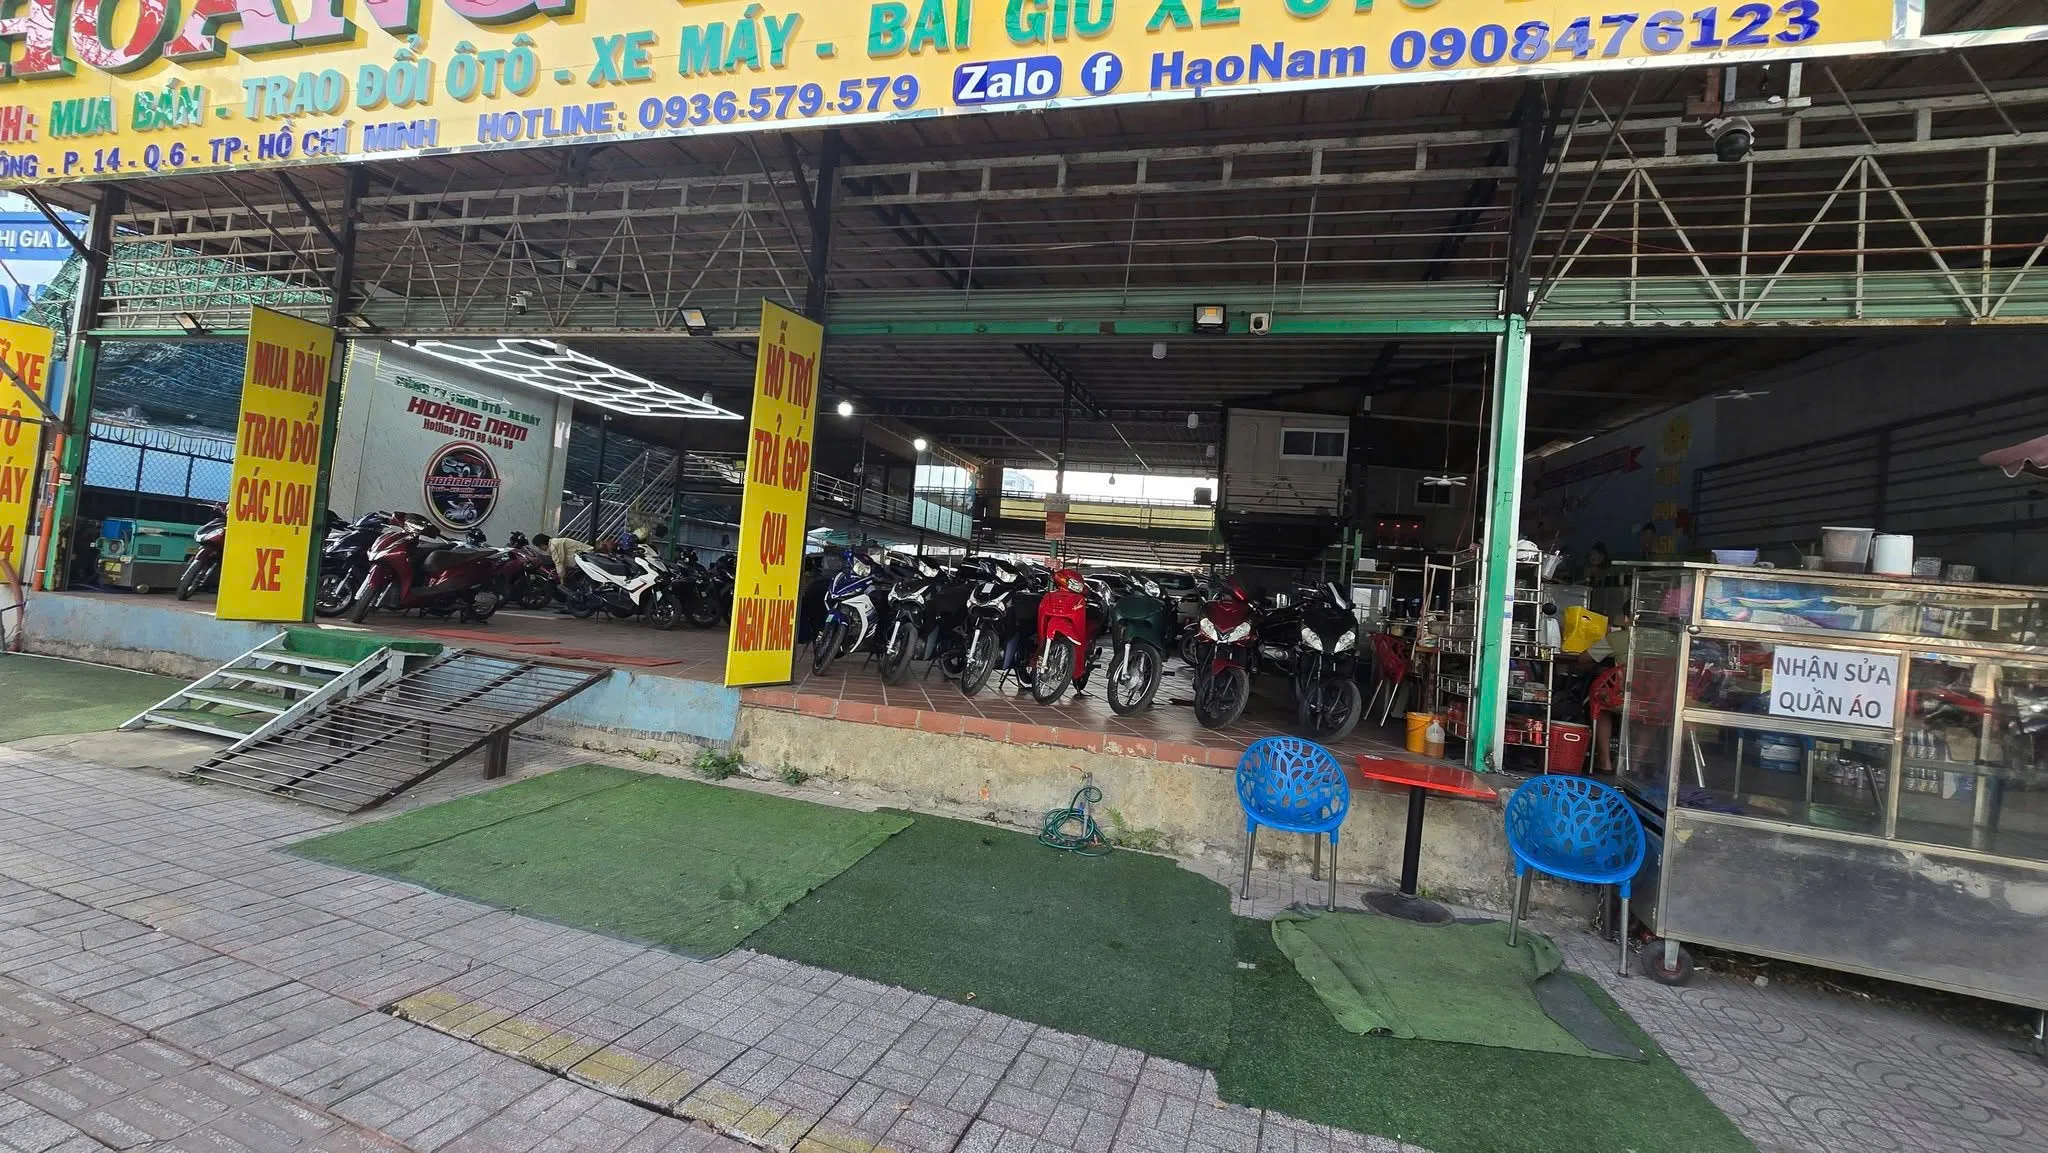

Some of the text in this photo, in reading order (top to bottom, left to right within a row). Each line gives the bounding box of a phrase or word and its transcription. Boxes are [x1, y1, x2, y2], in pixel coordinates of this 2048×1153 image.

[50, 97, 117, 138] MUA
[132, 78, 208, 132] BÁN
[242, 68, 348, 121] TRAO
[356, 33, 436, 110] ĐỔI
[446, 33, 537, 100] ÔTÔ
[587, 30, 657, 87] XE
[678, 4, 804, 78] MÁY
[957, 61, 1055, 101] Zalo
[1150, 41, 1367, 91] HaoNam
[1389, 0, 1822, 71] 0908476123
[208, 136, 250, 163] TP:
[257, 119, 295, 160] HỒ
[302, 119, 354, 157] CHÍ
[363, 118, 440, 151] MINH
[477, 101, 626, 143] HOTLINE:
[638, 74, 920, 130] 0936.579.579
[20, 229, 53, 248] GIA
[11, 351, 45, 391] XE
[251, 341, 326, 397] MUA BÁN
[763, 319, 816, 420] HỖ TRỢ
[242, 400, 320, 465] TRAO ĐỔI
[406, 395, 529, 442] HOÀNG NAM
[508, 409, 521, 421] XE
[753, 413, 810, 492] TRẢ GÓP
[235, 467, 312, 535] CÁC LOẠI
[251, 548, 285, 591] XE
[760, 510, 788, 575] QUA
[734, 583, 767, 652] NGÂN
[1776, 655, 1891, 686] NHẬN SỬA
[1779, 686, 1881, 719] QUẦN ÁO
